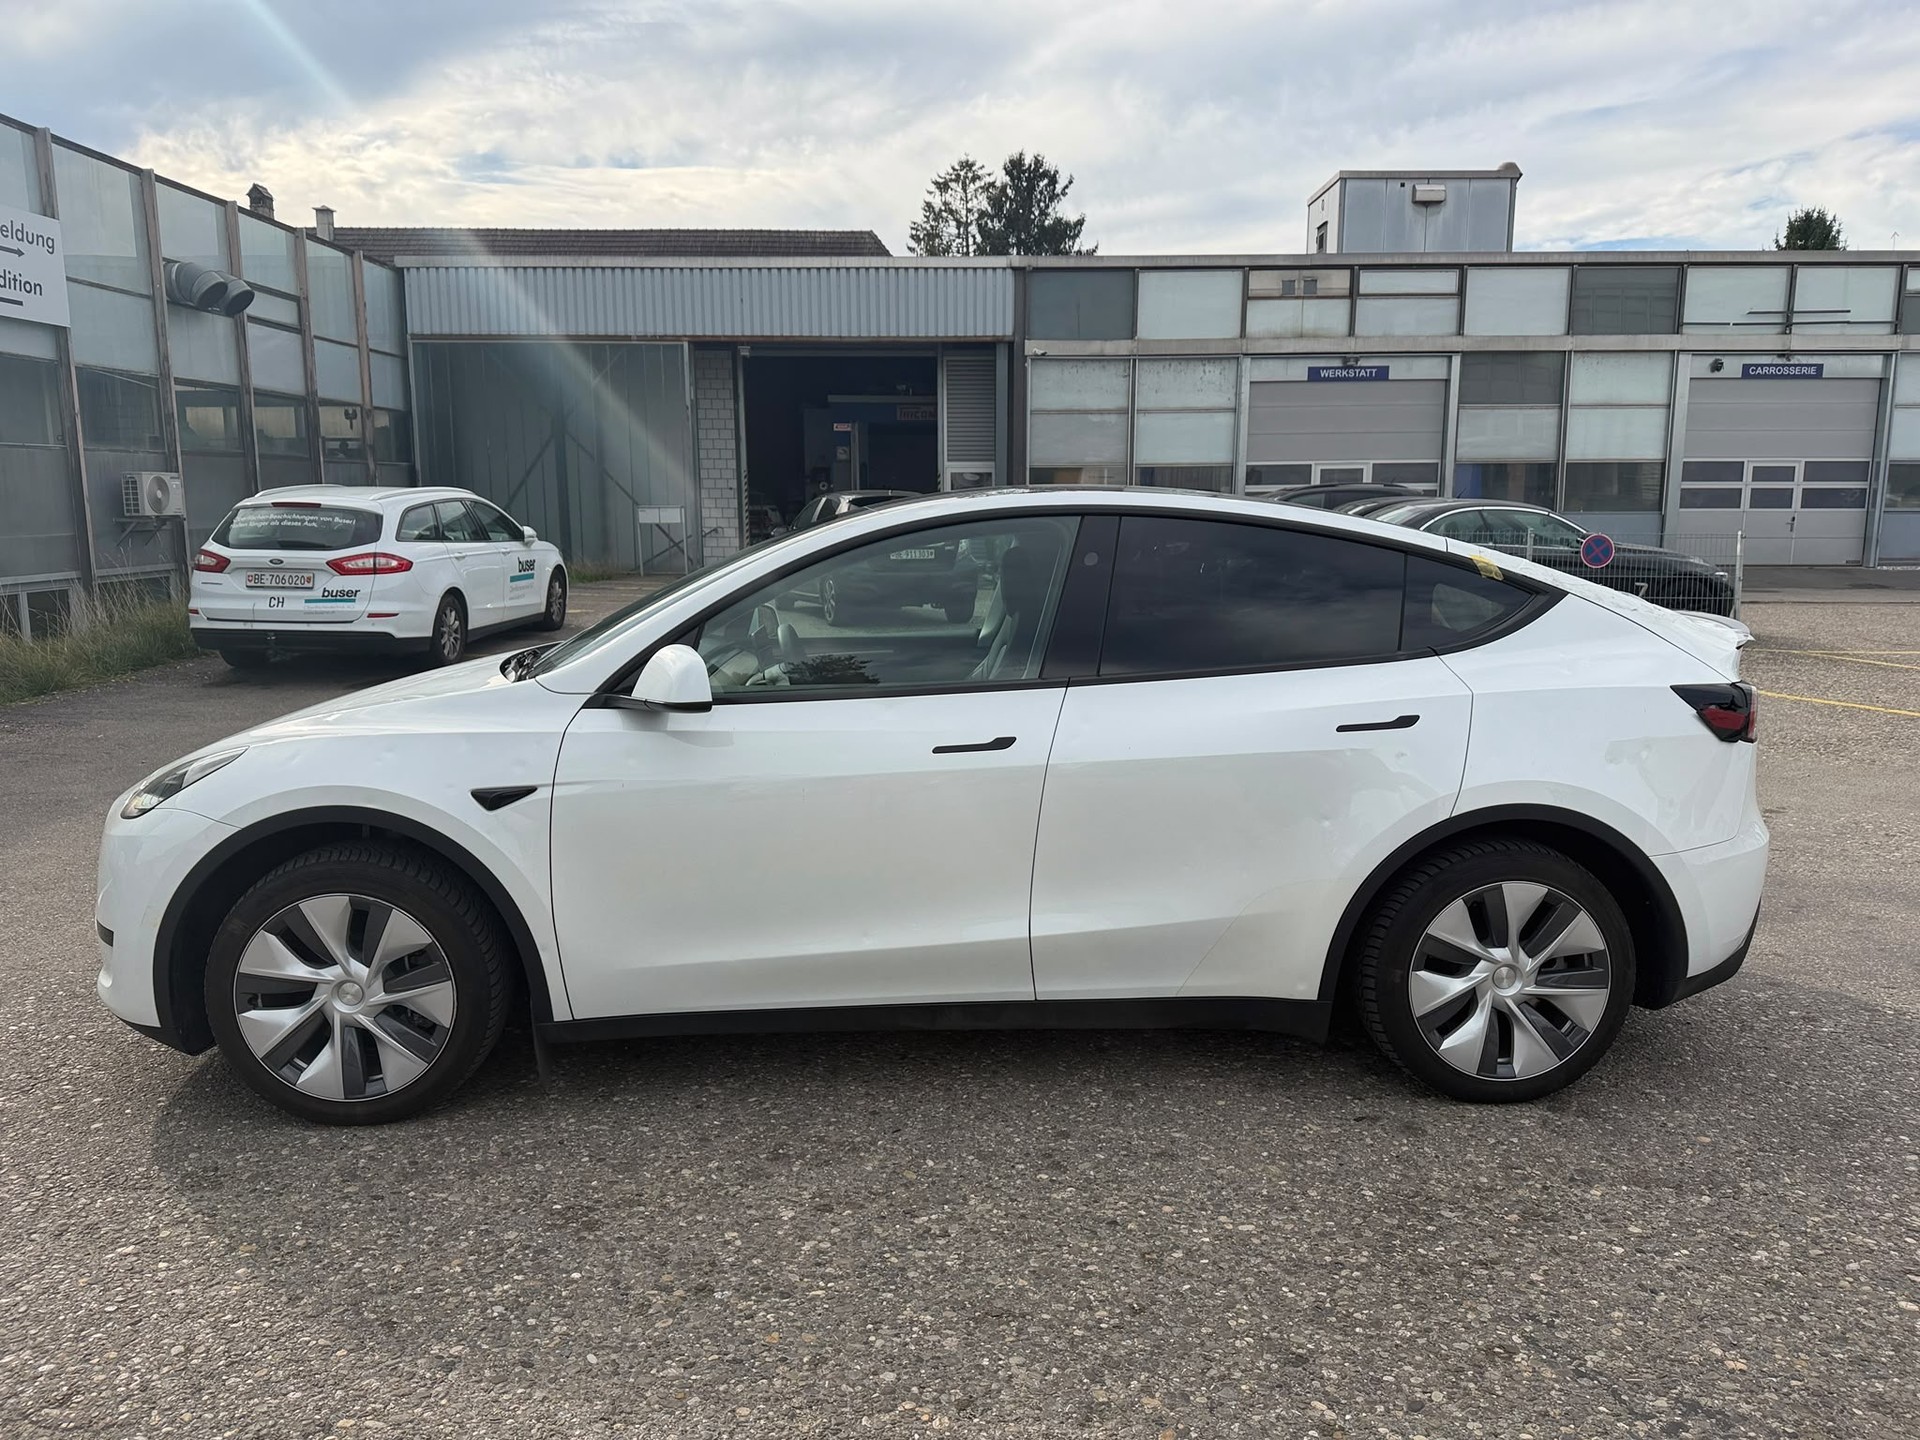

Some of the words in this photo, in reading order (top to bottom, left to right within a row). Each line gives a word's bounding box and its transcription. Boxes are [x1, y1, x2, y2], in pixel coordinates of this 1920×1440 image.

[0, 220, 55, 255] eldung
[0, 269, 43, 296] dition
[1320, 368, 1377, 378] WERKSTATT
[1749, 366, 1817, 375] CARROSSERIE
[517, 556, 536, 573] buser
[321, 587, 361, 598] buser
[268, 596, 285, 608] CH
